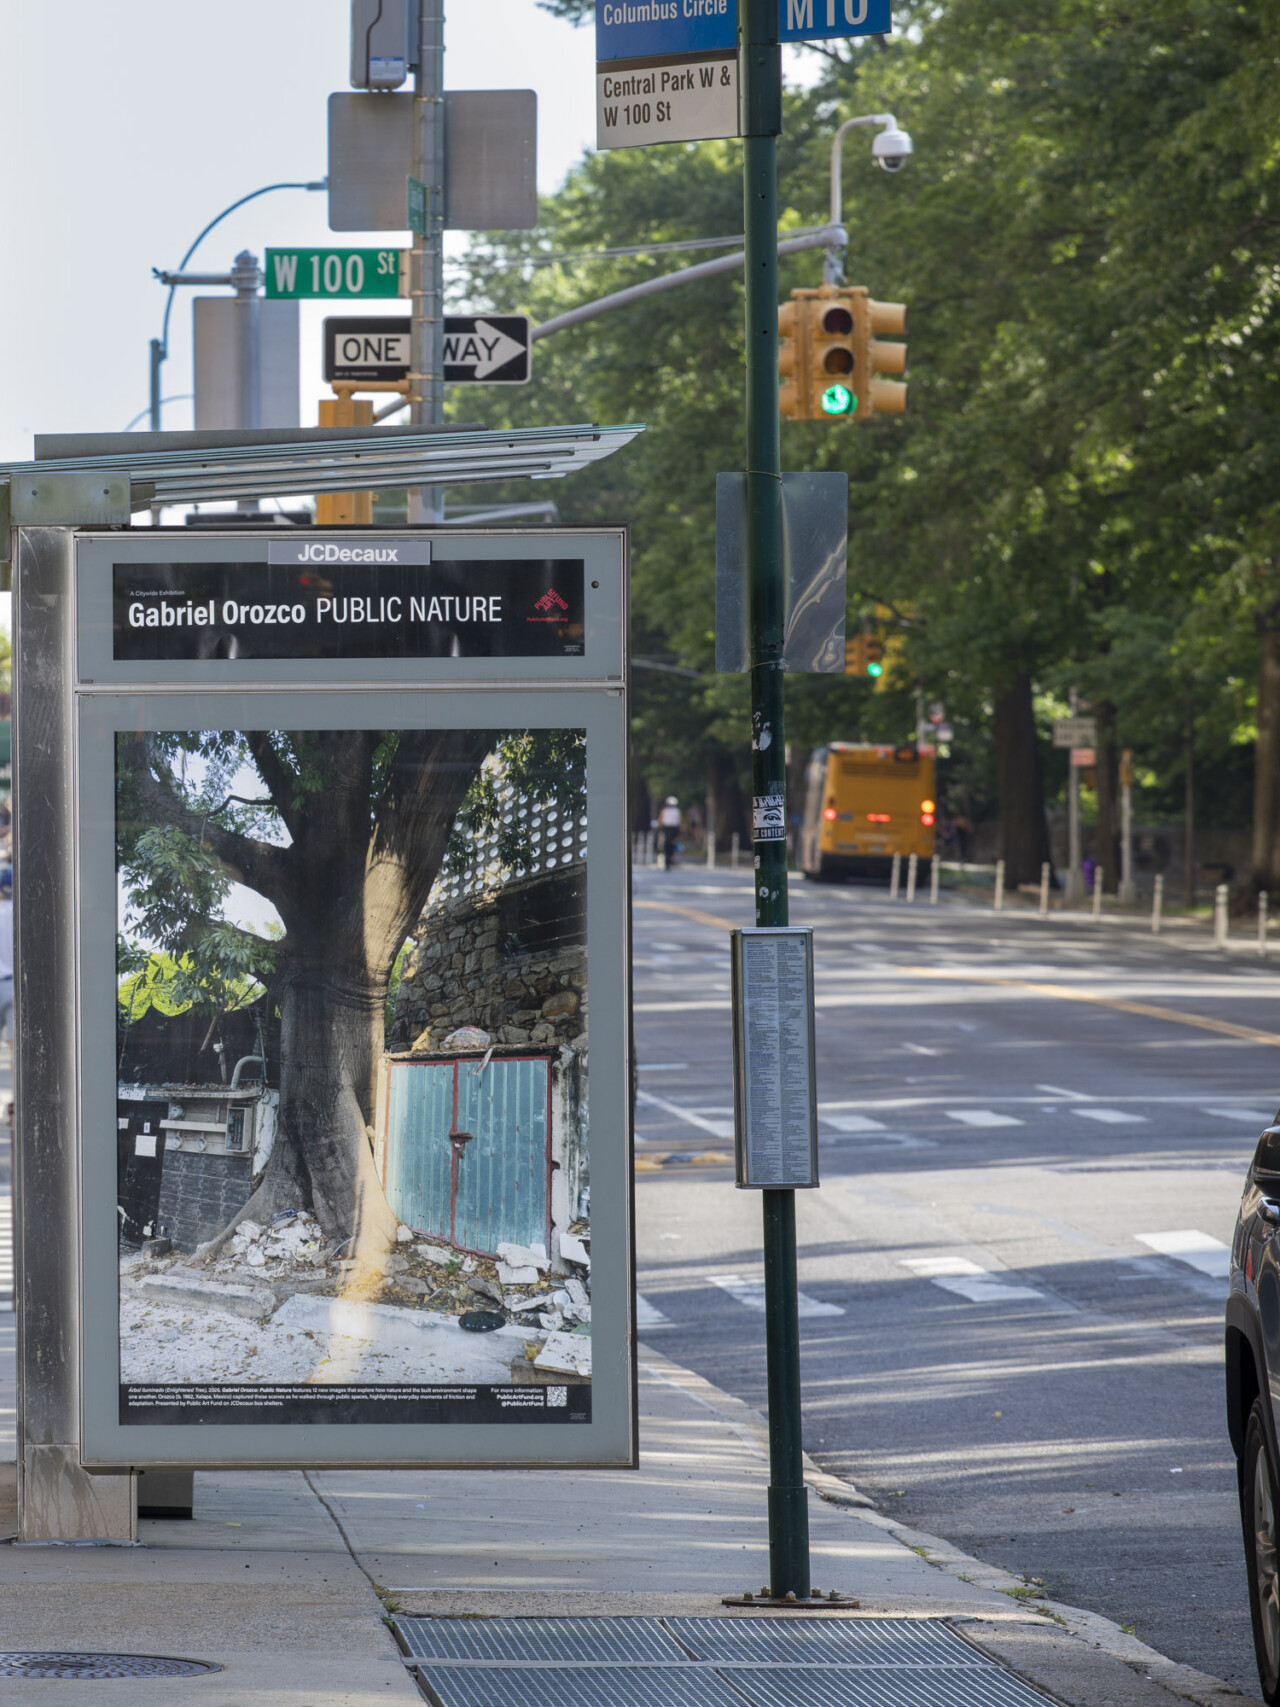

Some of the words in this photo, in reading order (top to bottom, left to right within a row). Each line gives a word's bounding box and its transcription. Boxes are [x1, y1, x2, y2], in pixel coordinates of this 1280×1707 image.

[603, 0, 678, 26] Columbus
[683, 0, 728, 17] Circle
[787, 0, 869, 30] M10
[603, 71, 656, 98] Central
[661, 69, 695, 93] Park
[699, 67, 714, 88] W
[720, 65, 731, 86] &
[604, 106, 619, 127] W
[623, 103, 651, 126] 100
[656, 101, 672, 123] St
[274, 255, 298, 292] W
[310, 254, 365, 293] 100
[377, 252, 395, 275] St
[342, 337, 402, 362] ONE
[443, 337, 501, 362] WAY
[297, 544, 399, 563] JCDecaux
[128, 600, 216, 627] Gabriel
[222, 600, 306, 626] Orozco
[316, 596, 403, 624] PUBLIC
[410, 595, 503, 623] NATURE
[534, 588, 555, 610] PUBLIC
